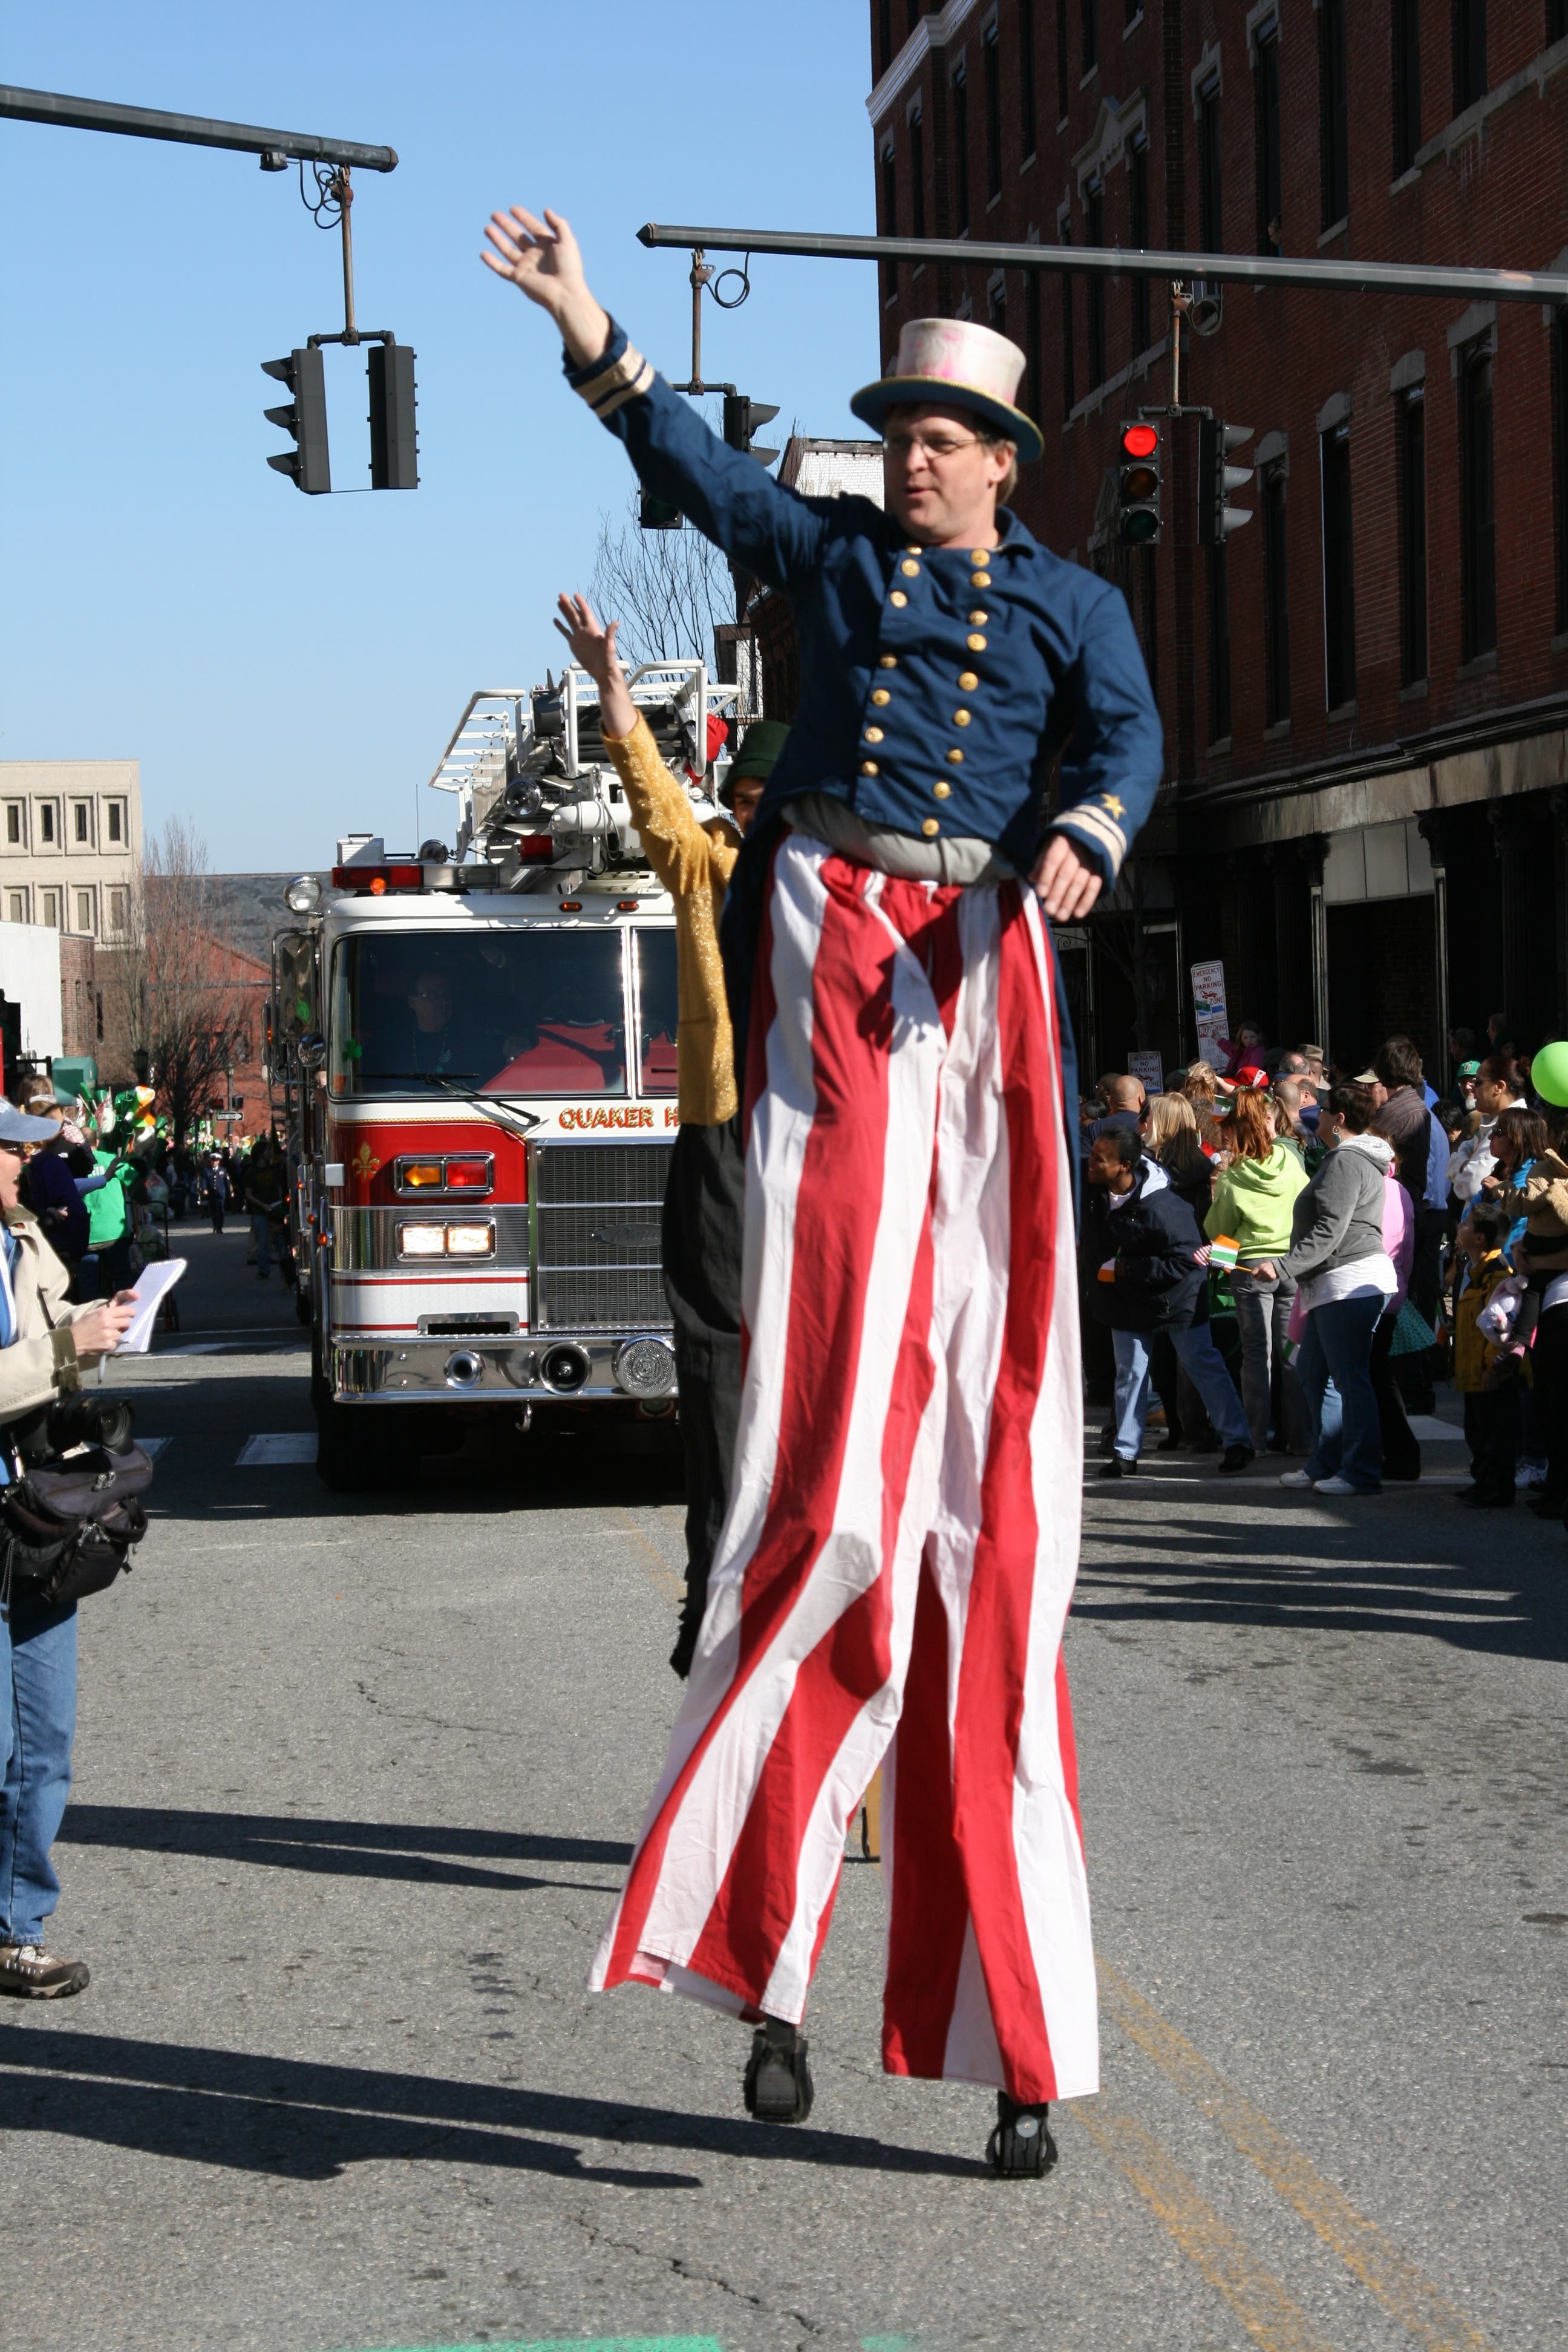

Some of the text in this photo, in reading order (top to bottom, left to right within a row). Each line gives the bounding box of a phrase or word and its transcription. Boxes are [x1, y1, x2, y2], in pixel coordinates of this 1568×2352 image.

[1193, 968, 1220, 977] EMERGENCY
[1195, 981, 1221, 991] PARKING
[1210, 996, 1224, 1005] ZONE
[1200, 1024, 1207, 1035] NO
[558, 1106, 655, 1131] QUAKER
